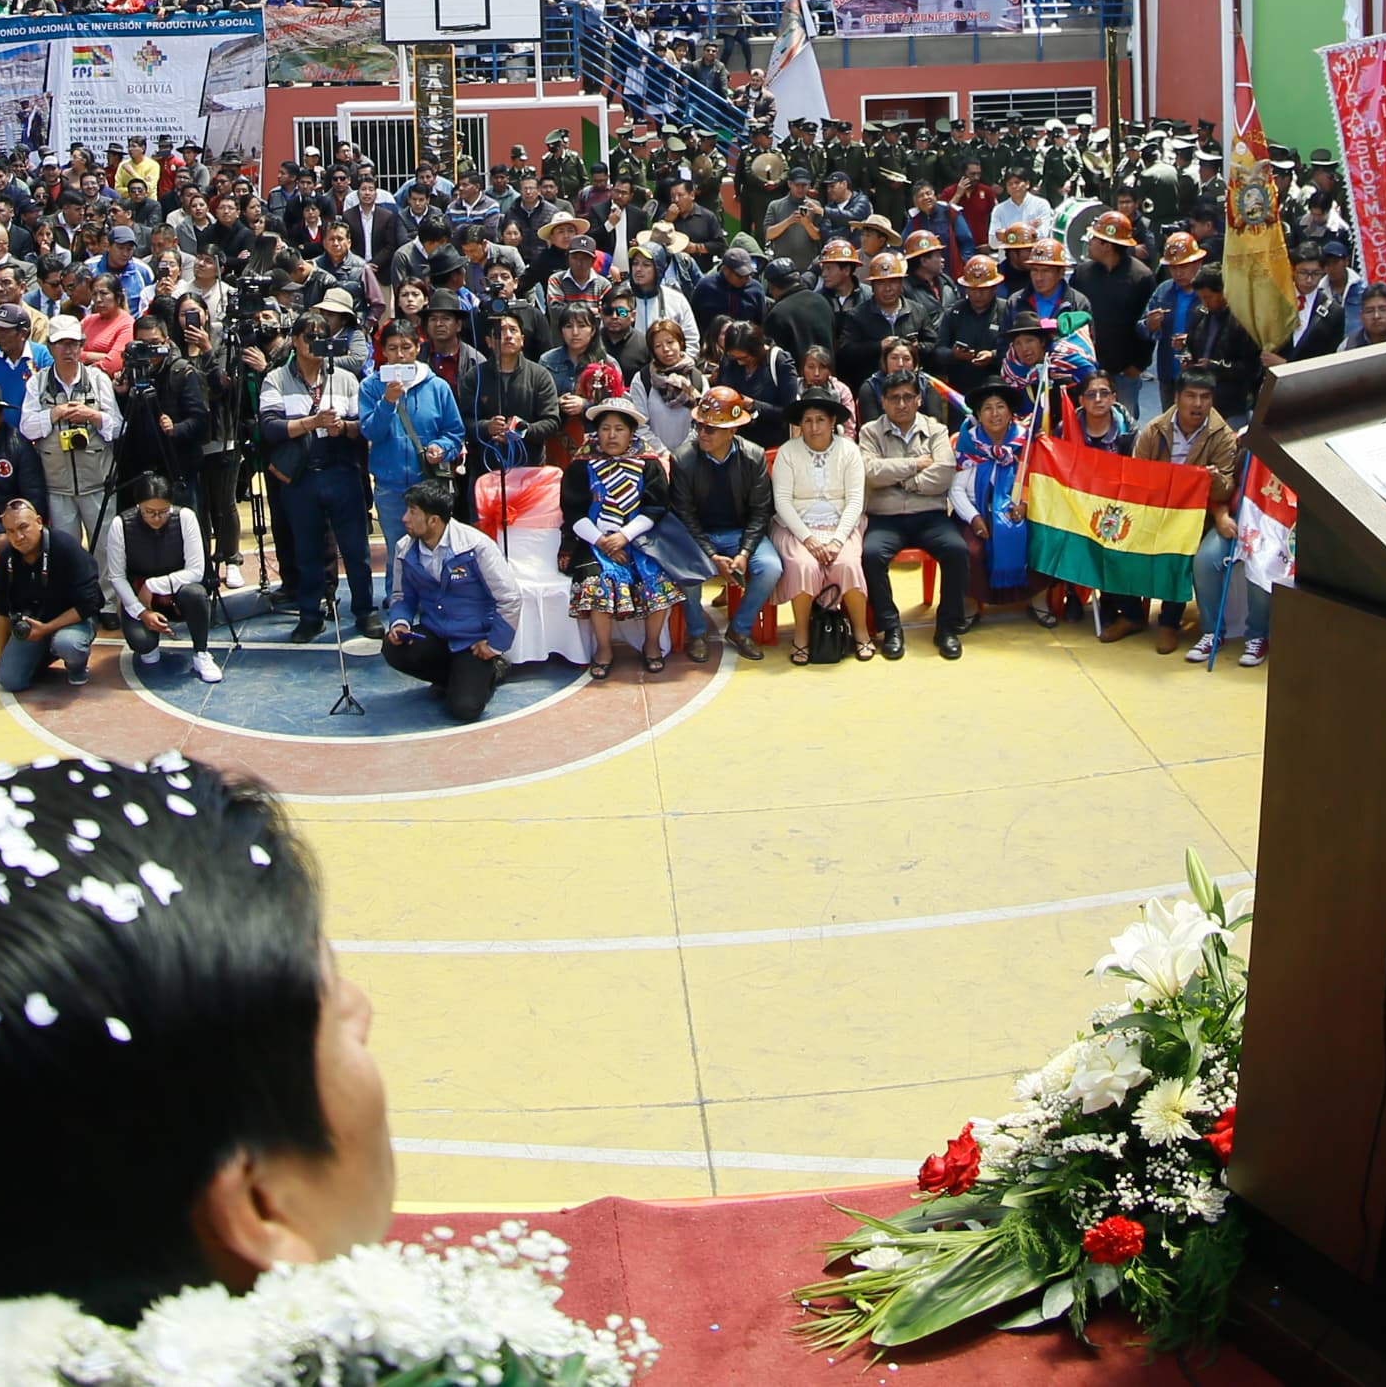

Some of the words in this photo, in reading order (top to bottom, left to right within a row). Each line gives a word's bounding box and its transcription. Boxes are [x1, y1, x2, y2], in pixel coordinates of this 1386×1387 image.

[864, 13, 910, 24] DISTRITO
[912, 11, 965, 23] MUNICIPAL
[28, 24, 75, 35] NACIONAL
[77, 22, 90, 31] DE
[91, 20, 141, 31] INVERSIÓN
[146, 20, 208, 30] PRODUCTIVA
[210, 19, 217, 27] Y
[218, 18, 255, 27] SOCIAL
[72, 66, 93, 78] FPS
[127, 83, 173, 94] BOLIVIA
[1369, 121, 1386, 164] DE
